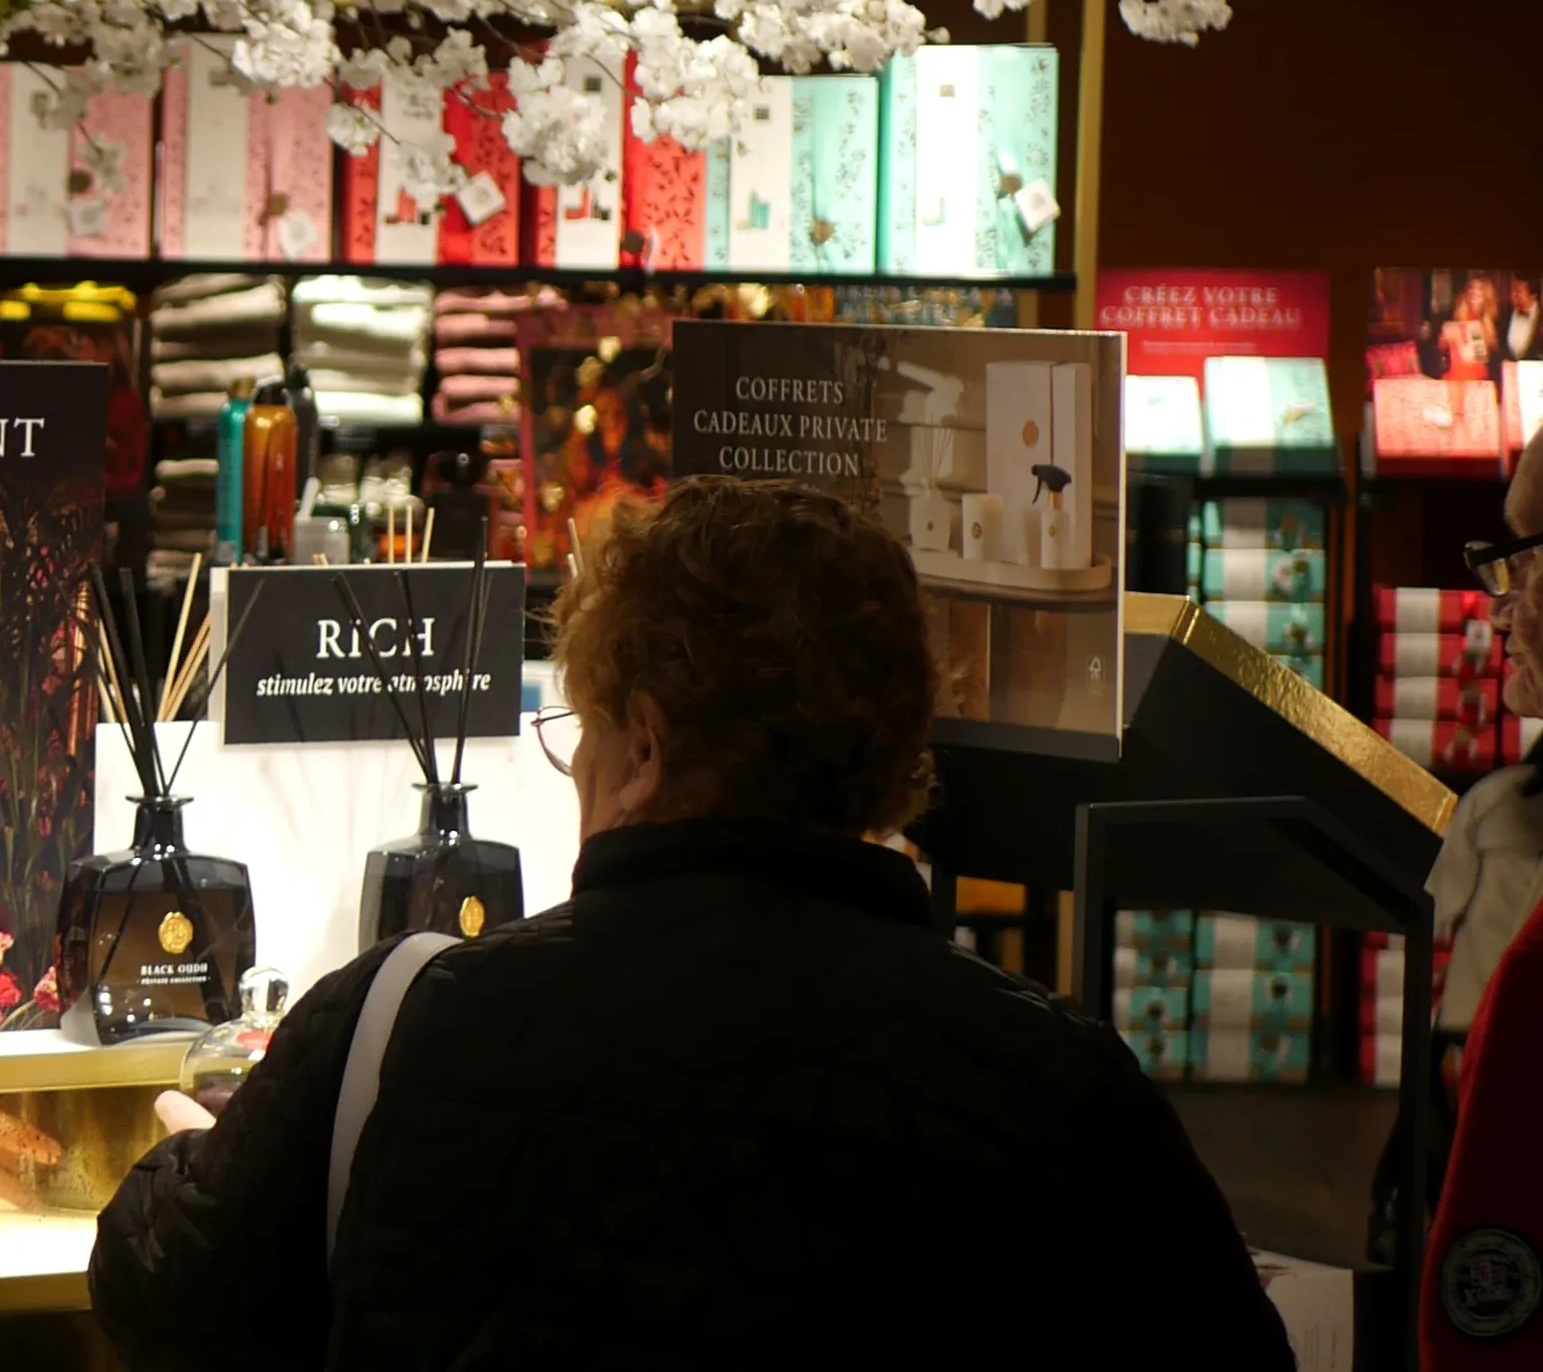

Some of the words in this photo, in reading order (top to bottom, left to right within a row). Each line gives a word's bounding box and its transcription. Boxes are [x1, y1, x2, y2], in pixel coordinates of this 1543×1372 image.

[1124, 283, 1197, 306] CRÉEZ
[1203, 286, 1278, 307] VOTRE
[1101, 305, 1203, 328] COFFRET
[1210, 305, 1303, 327] CADEAU
[735, 376, 845, 404] COFFRETS
[693, 409, 793, 439] CADEAUX
[799, 414, 888, 443] PRIVATE
[718, 445, 860, 478] COLLECTION
[316, 617, 435, 658] RICH
[256, 671, 333, 696] stimulez
[338, 672, 382, 695] votre
[387, 668, 491, 697] atmosphre
[140, 964, 175, 976] BLACK
